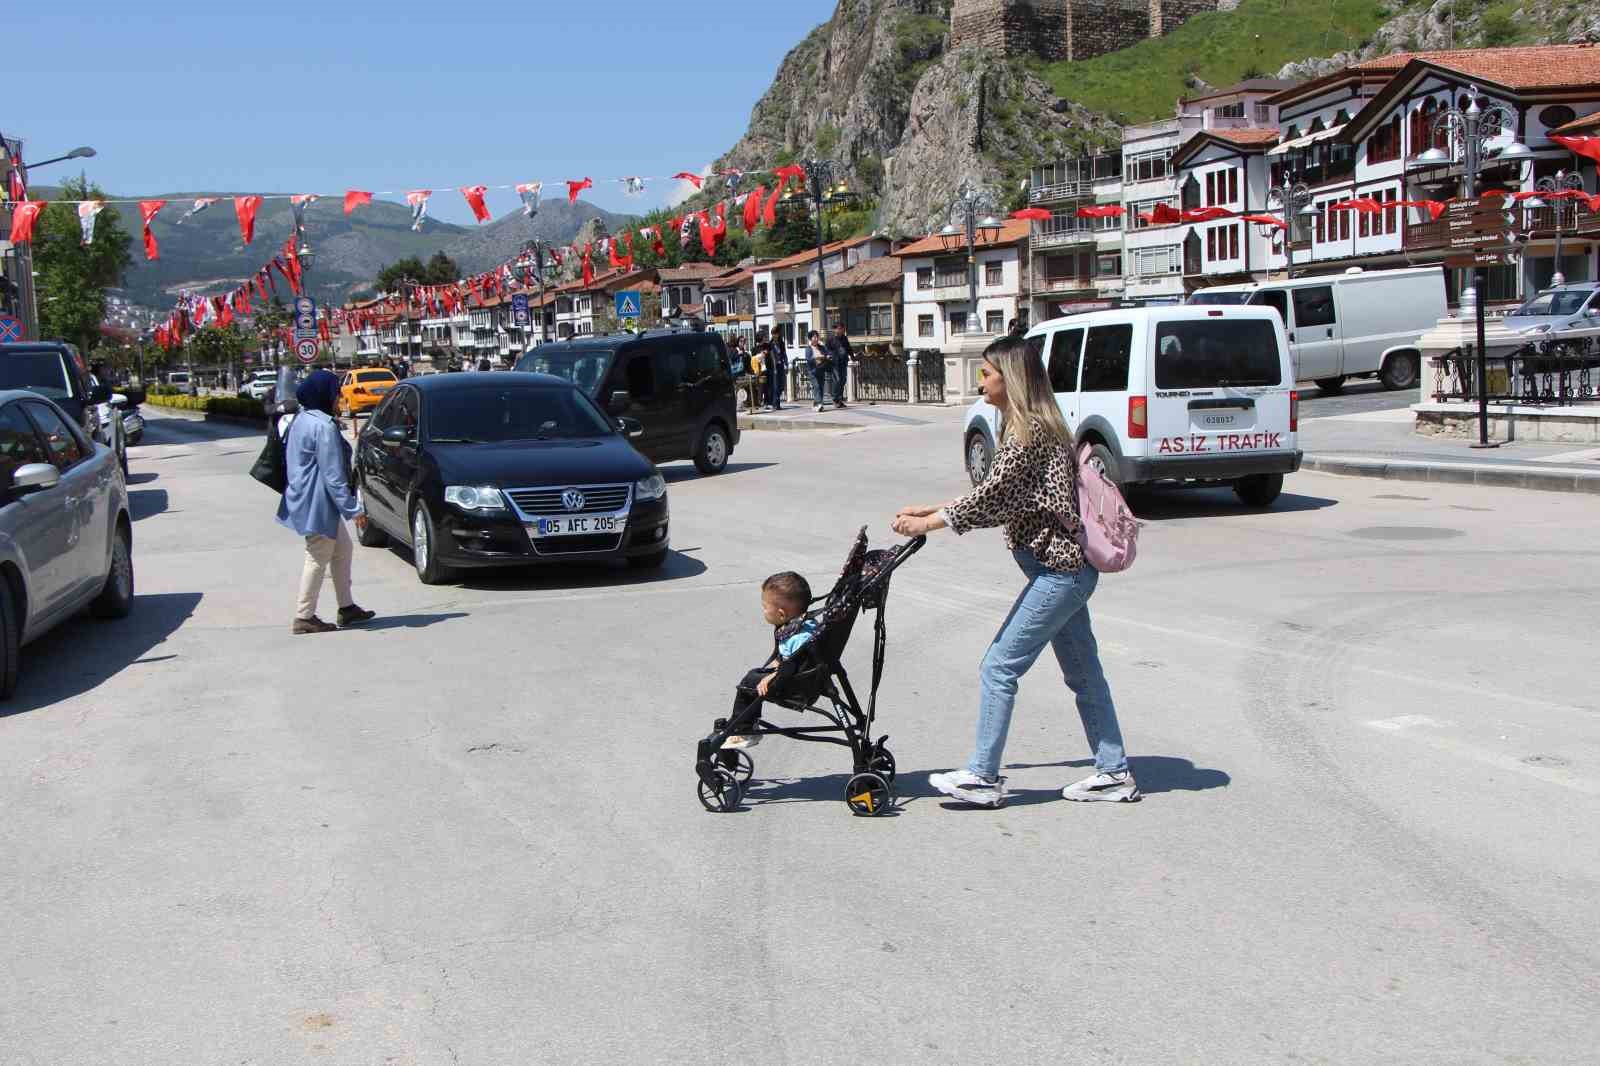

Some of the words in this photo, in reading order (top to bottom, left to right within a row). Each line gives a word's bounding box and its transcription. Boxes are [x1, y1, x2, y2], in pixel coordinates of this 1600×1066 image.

[302, 345, 314, 355] 30
[1159, 433, 1211, 453] AS.İZ.
[1217, 430, 1280, 450] TRAFİK
[546, 521, 560, 533] 05
[568, 519, 587, 532] AFC
[594, 517, 614, 530] 205
